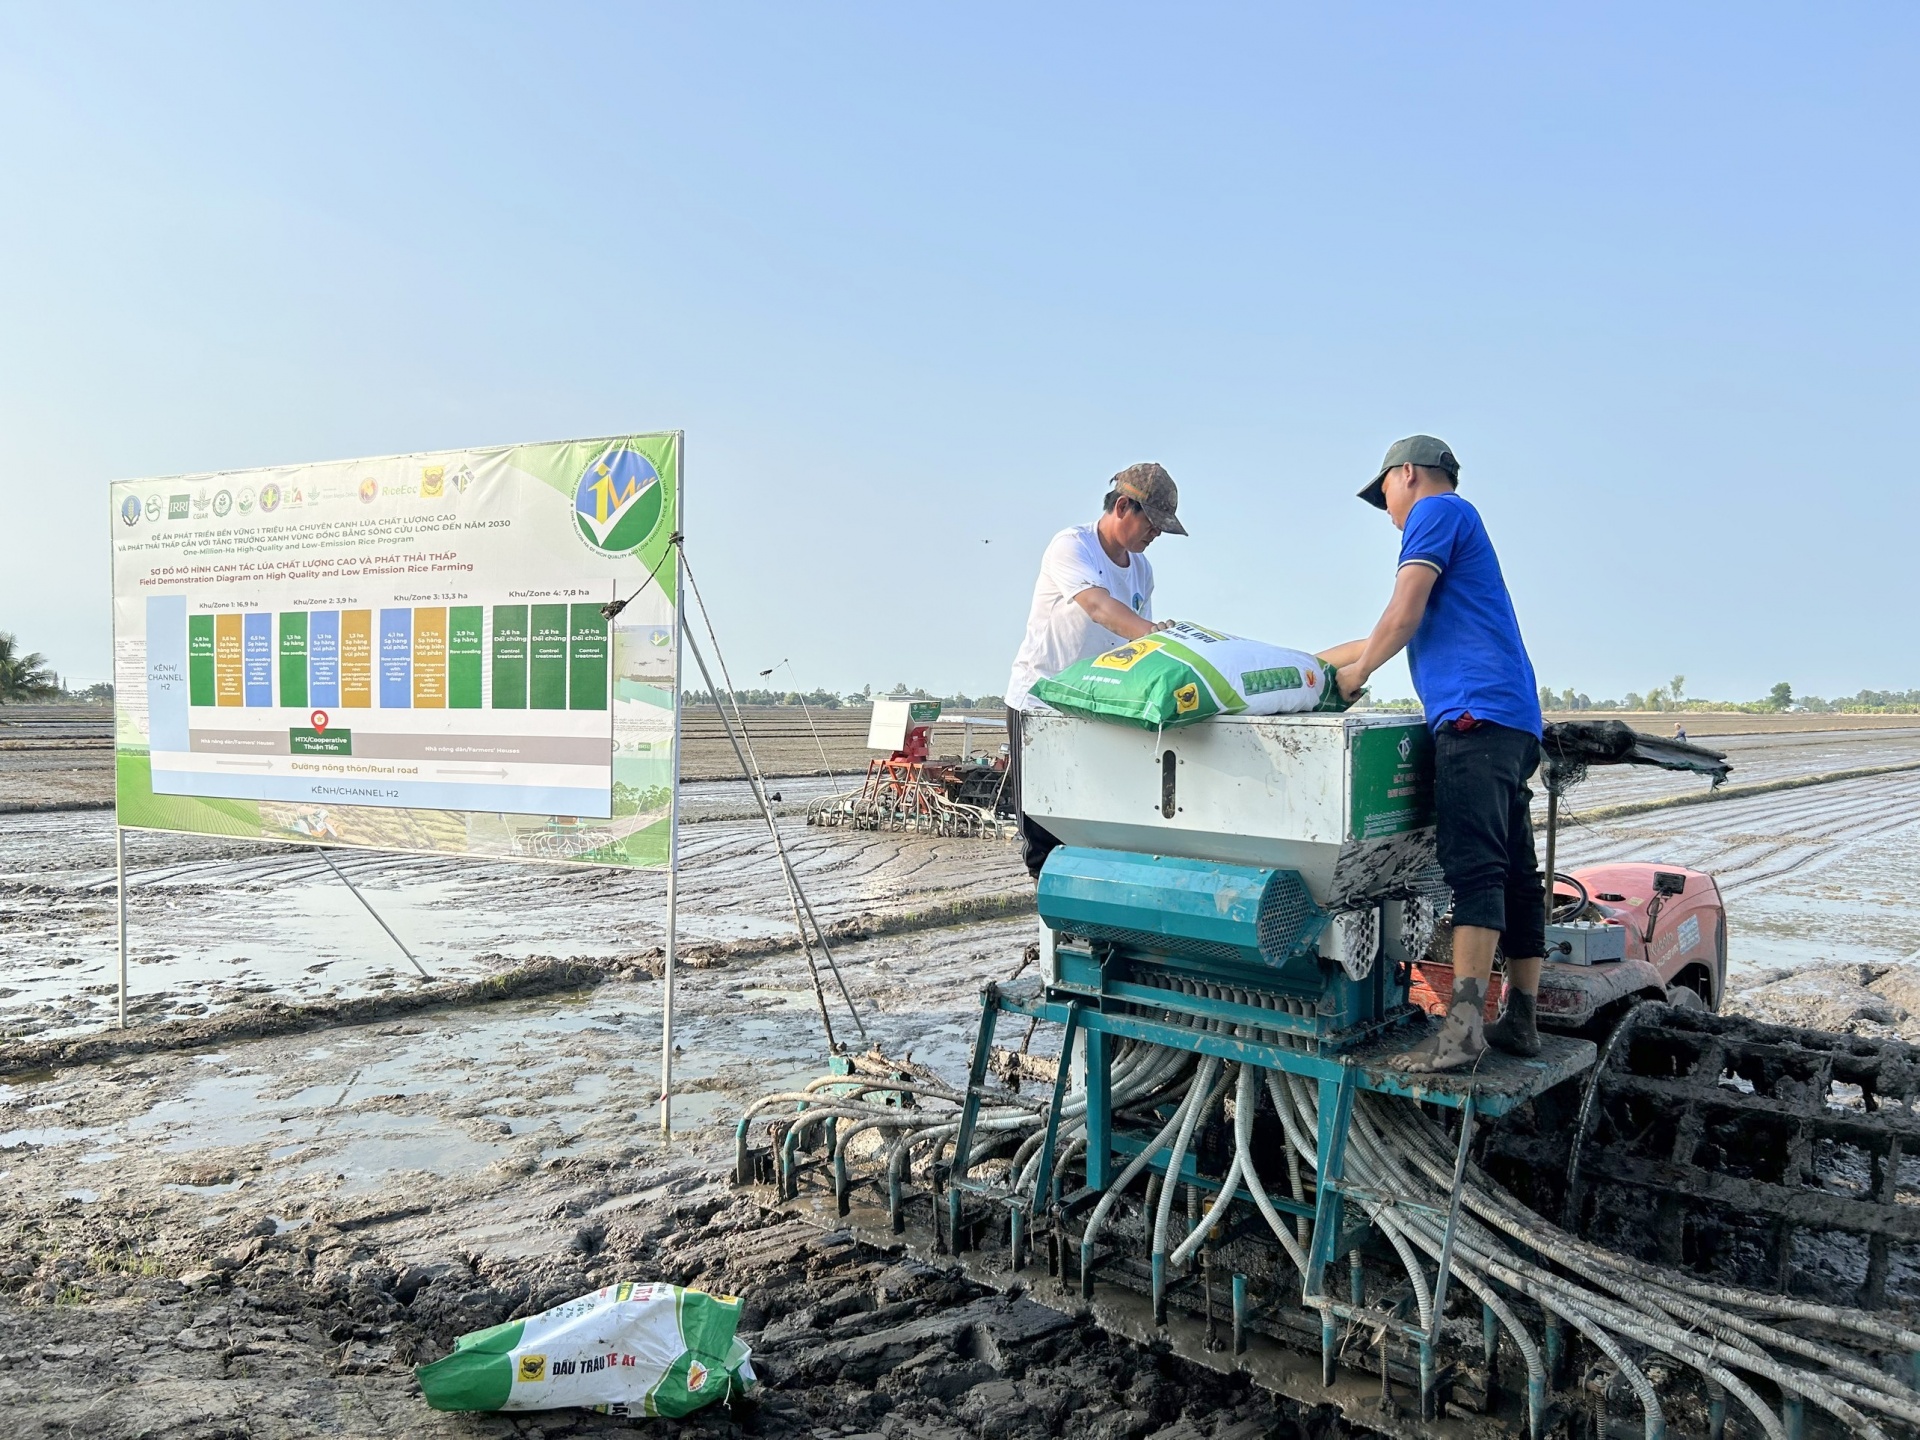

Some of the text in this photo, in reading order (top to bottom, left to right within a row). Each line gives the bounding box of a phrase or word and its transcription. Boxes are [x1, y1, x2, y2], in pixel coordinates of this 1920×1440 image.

[170, 501, 188, 512] IRRI
[182, 546, 234, 555] One-Million-Ha
[236, 543, 283, 553] High-Quality
[301, 539, 355, 548] Low-Emission
[377, 536, 414, 544] Program
[157, 575, 214, 584] Demonstration
[216, 573, 250, 582] Diagram
[266, 571, 286, 580] High
[288, 570, 320, 579] Quality
[362, 566, 404, 574] Emission
[431, 562, 473, 573] Farming
[291, 762, 418, 774] Đường nông thôn/Rural road
[311, 786, 383, 798] KÊNH/CHANNEL
[580, 1356, 605, 1374] TRÂU
[606, 1353, 618, 1367] TE
[622, 1354, 636, 1366] A1
